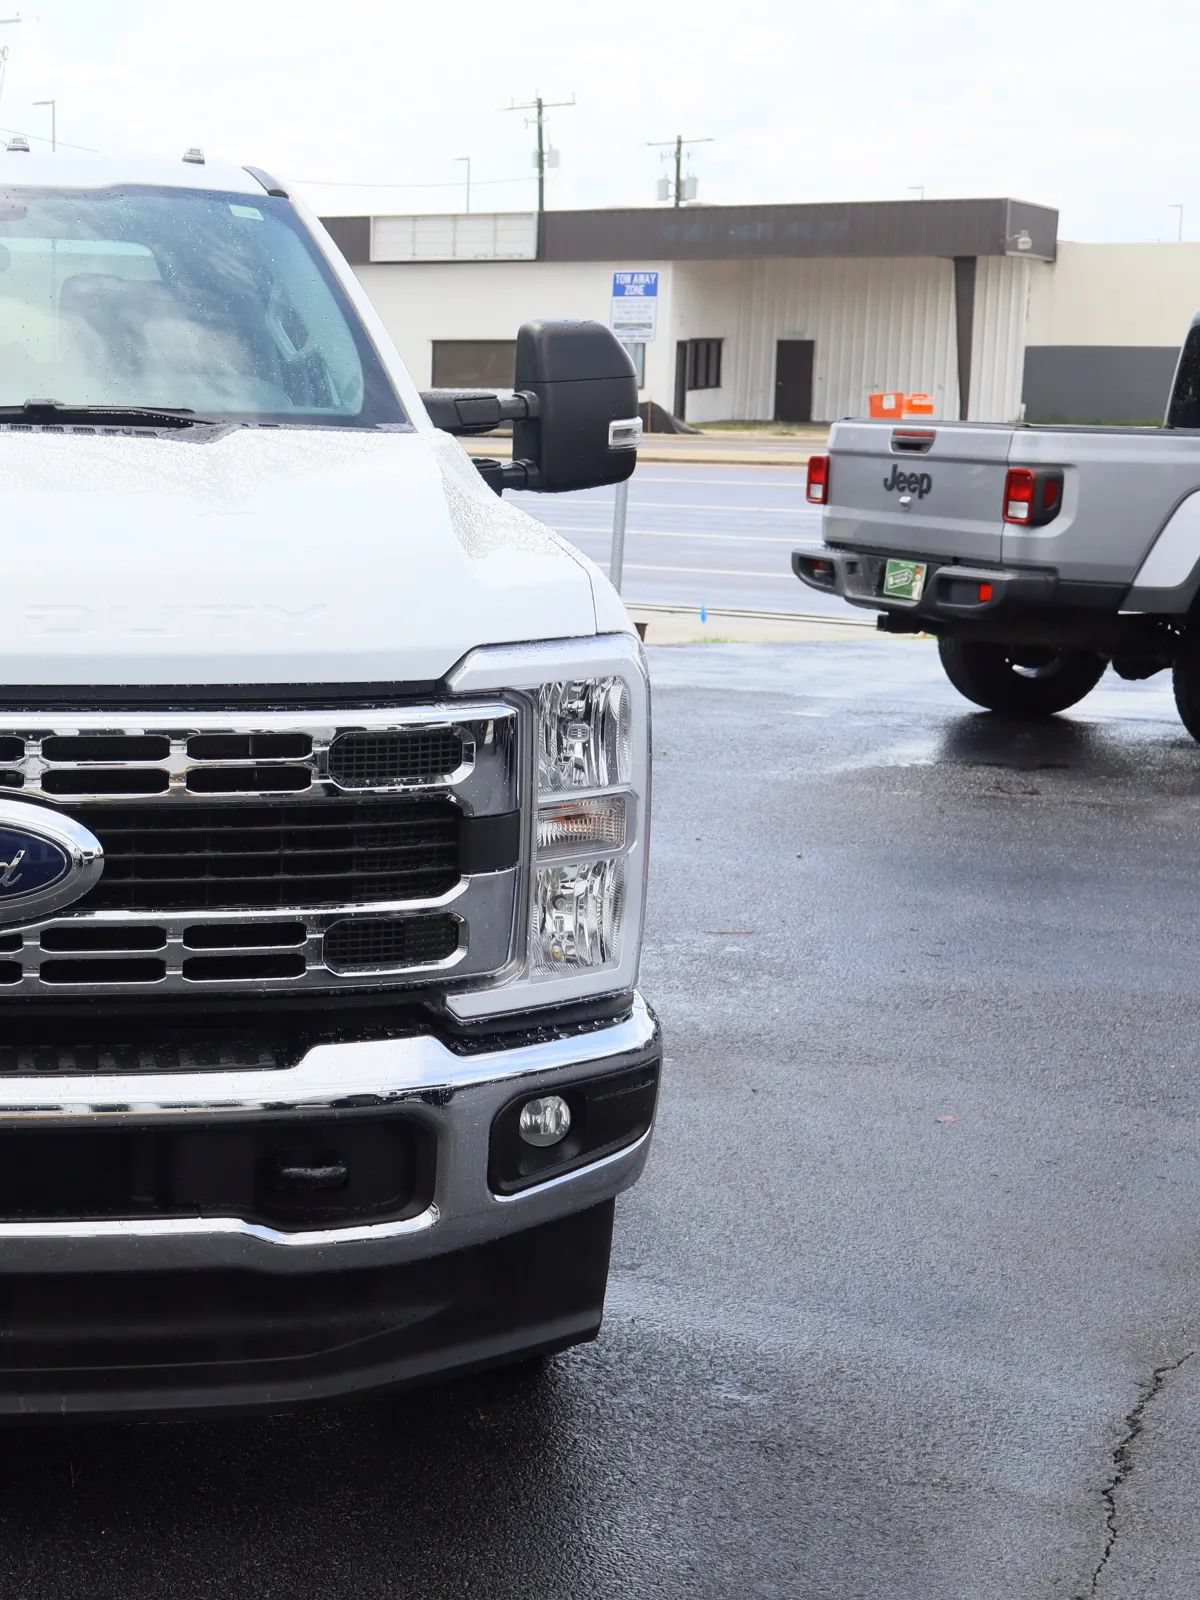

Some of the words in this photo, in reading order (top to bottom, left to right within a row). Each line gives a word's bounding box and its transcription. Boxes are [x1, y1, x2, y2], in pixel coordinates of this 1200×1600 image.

[615, 273, 632, 285] TOW
[632, 273, 657, 285] AWAY
[624, 284, 646, 296] ZONE
[883, 463, 932, 500] Jeep
[22, 601, 329, 639] DUTY
